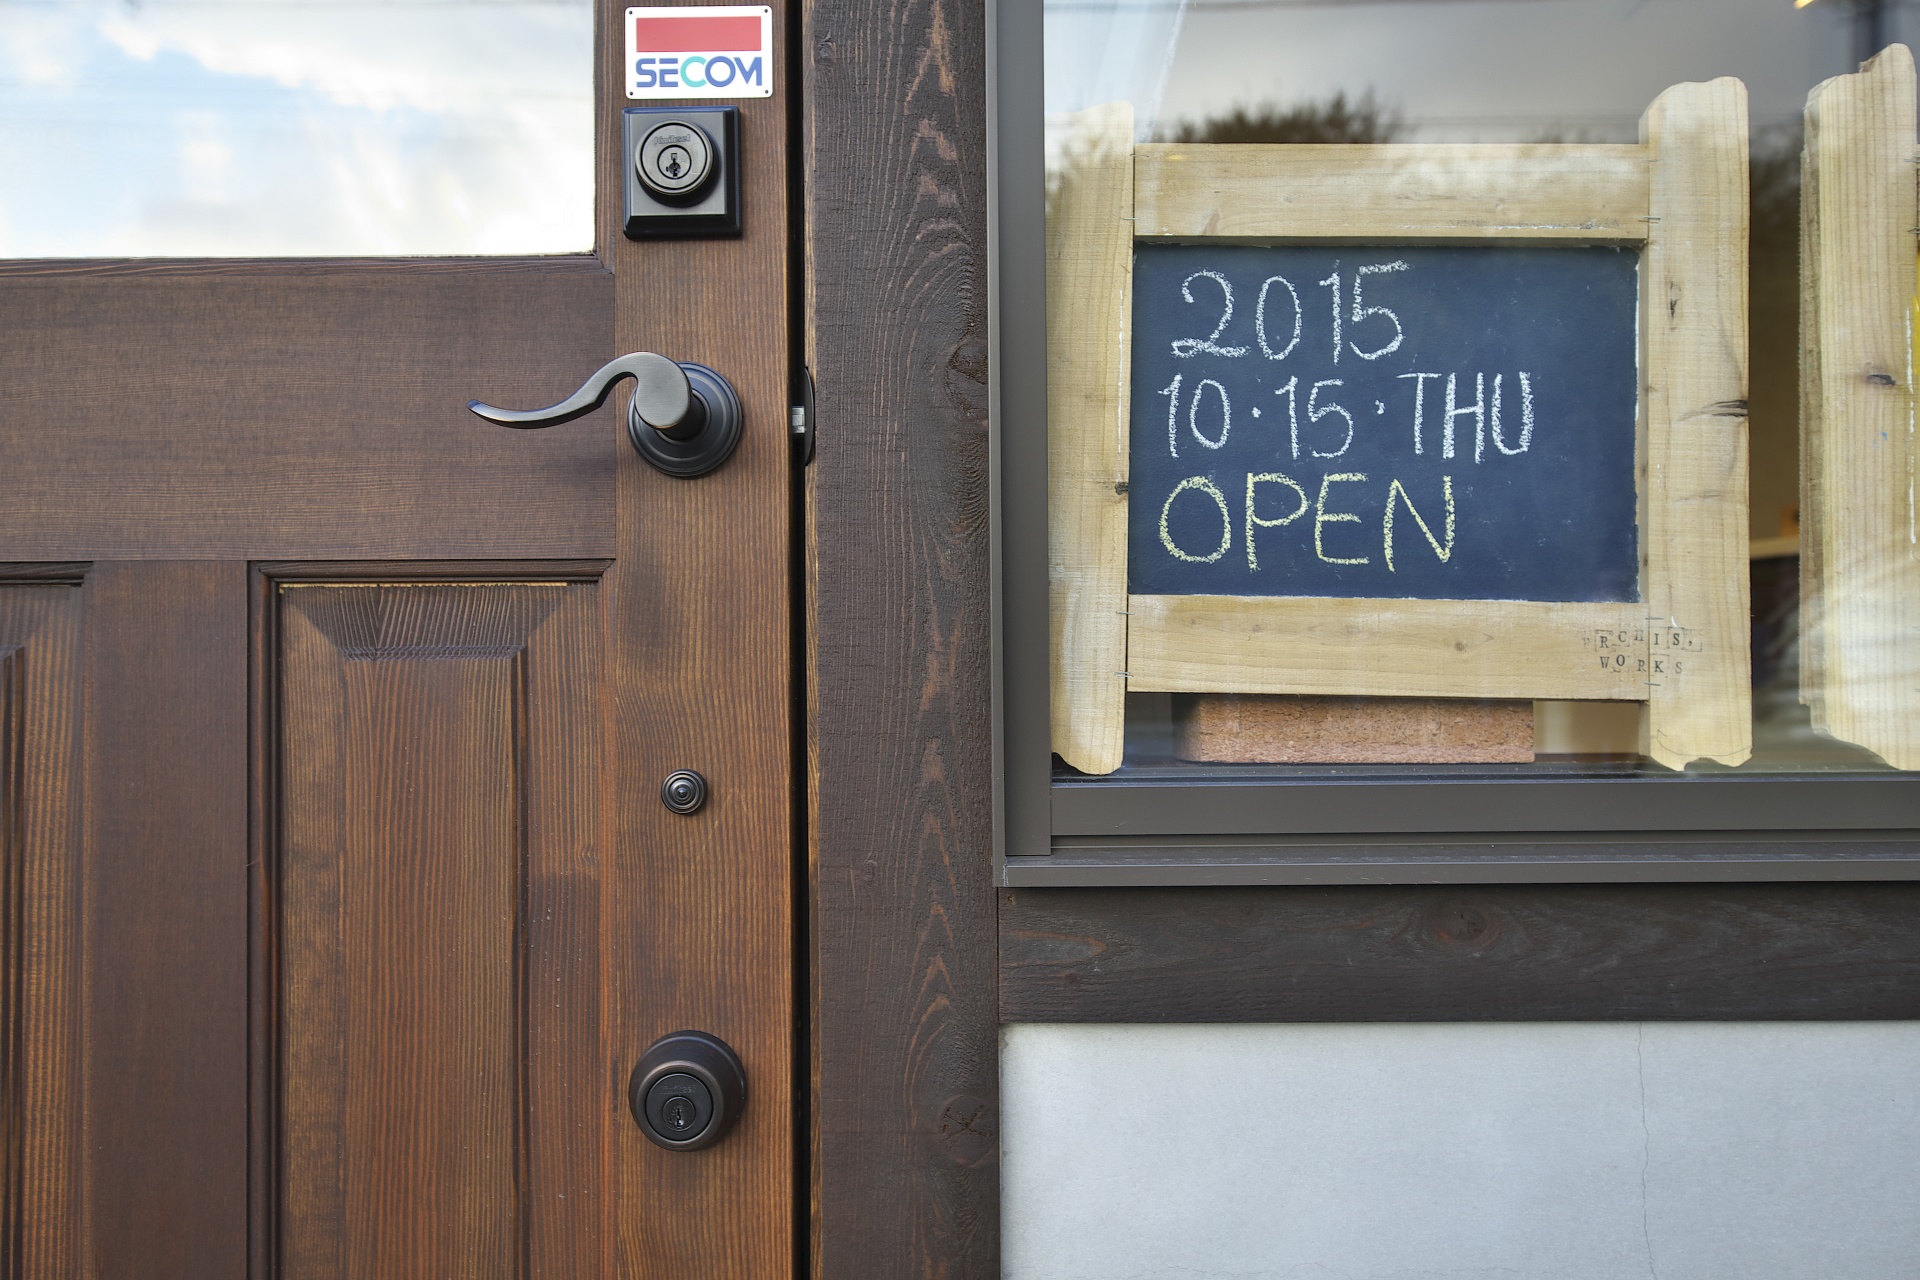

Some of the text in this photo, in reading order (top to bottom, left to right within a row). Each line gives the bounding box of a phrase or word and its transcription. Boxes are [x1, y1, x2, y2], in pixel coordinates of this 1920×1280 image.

[635, 55, 763, 88] SECOM
[1170, 259, 1409, 366] 2015
[1158, 472, 1456, 573] OPEN
[1599, 653, 1683, 674] WORKS
